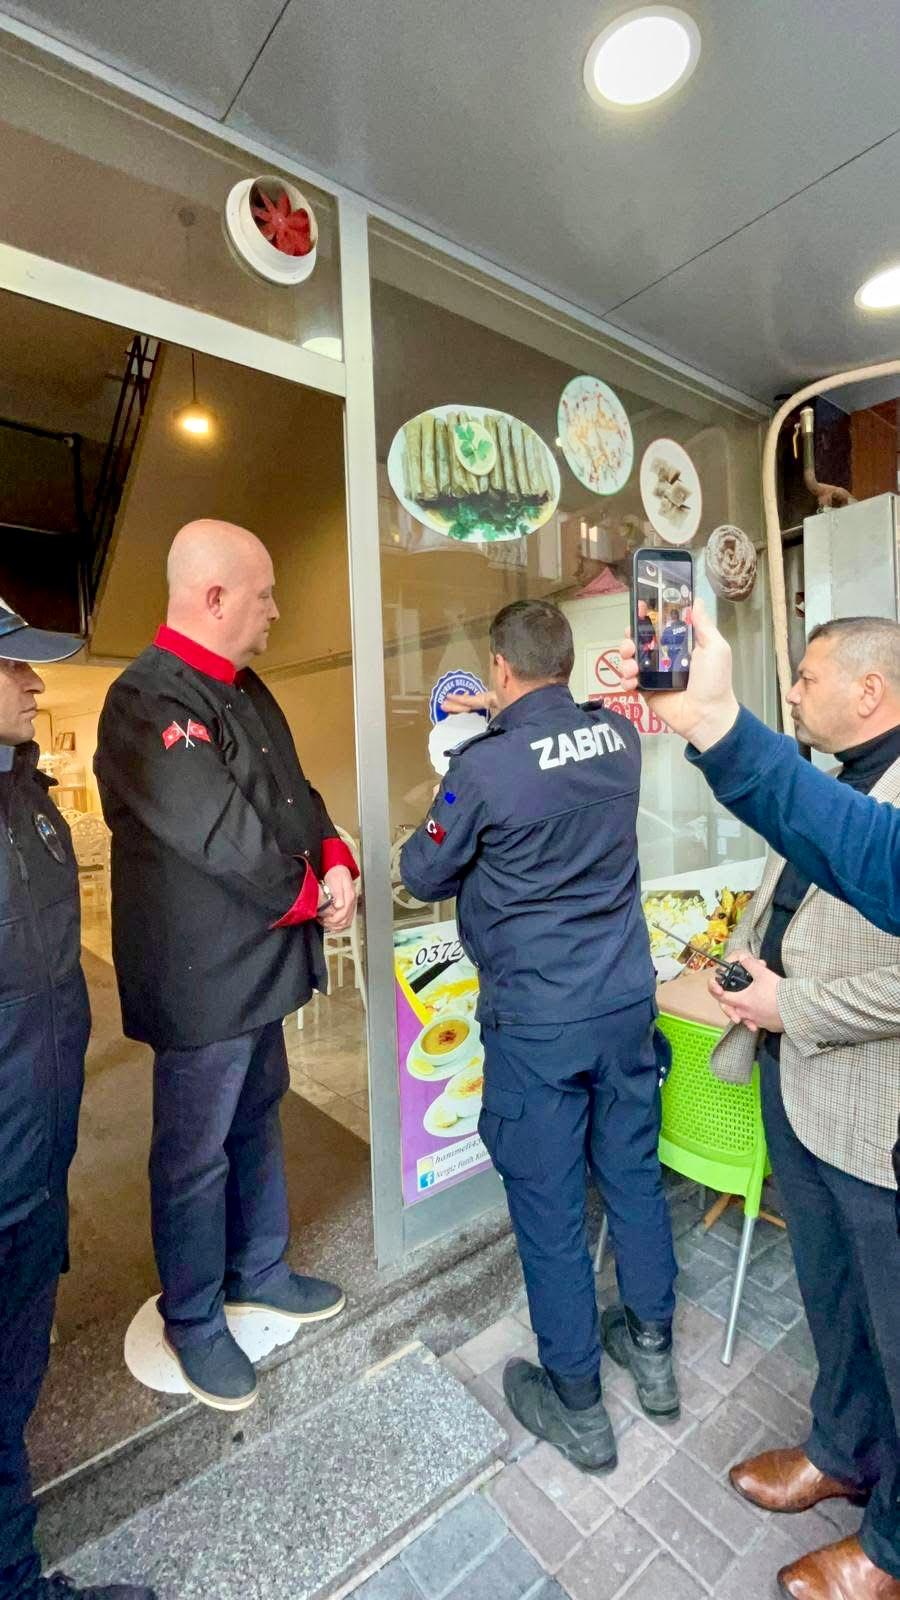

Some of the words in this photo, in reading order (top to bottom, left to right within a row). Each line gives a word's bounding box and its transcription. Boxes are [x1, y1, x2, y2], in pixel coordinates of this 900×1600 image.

[609, 701, 671, 734] ORB
[530, 723, 627, 770] ZABITA
[415, 940, 463, 966] 0372
